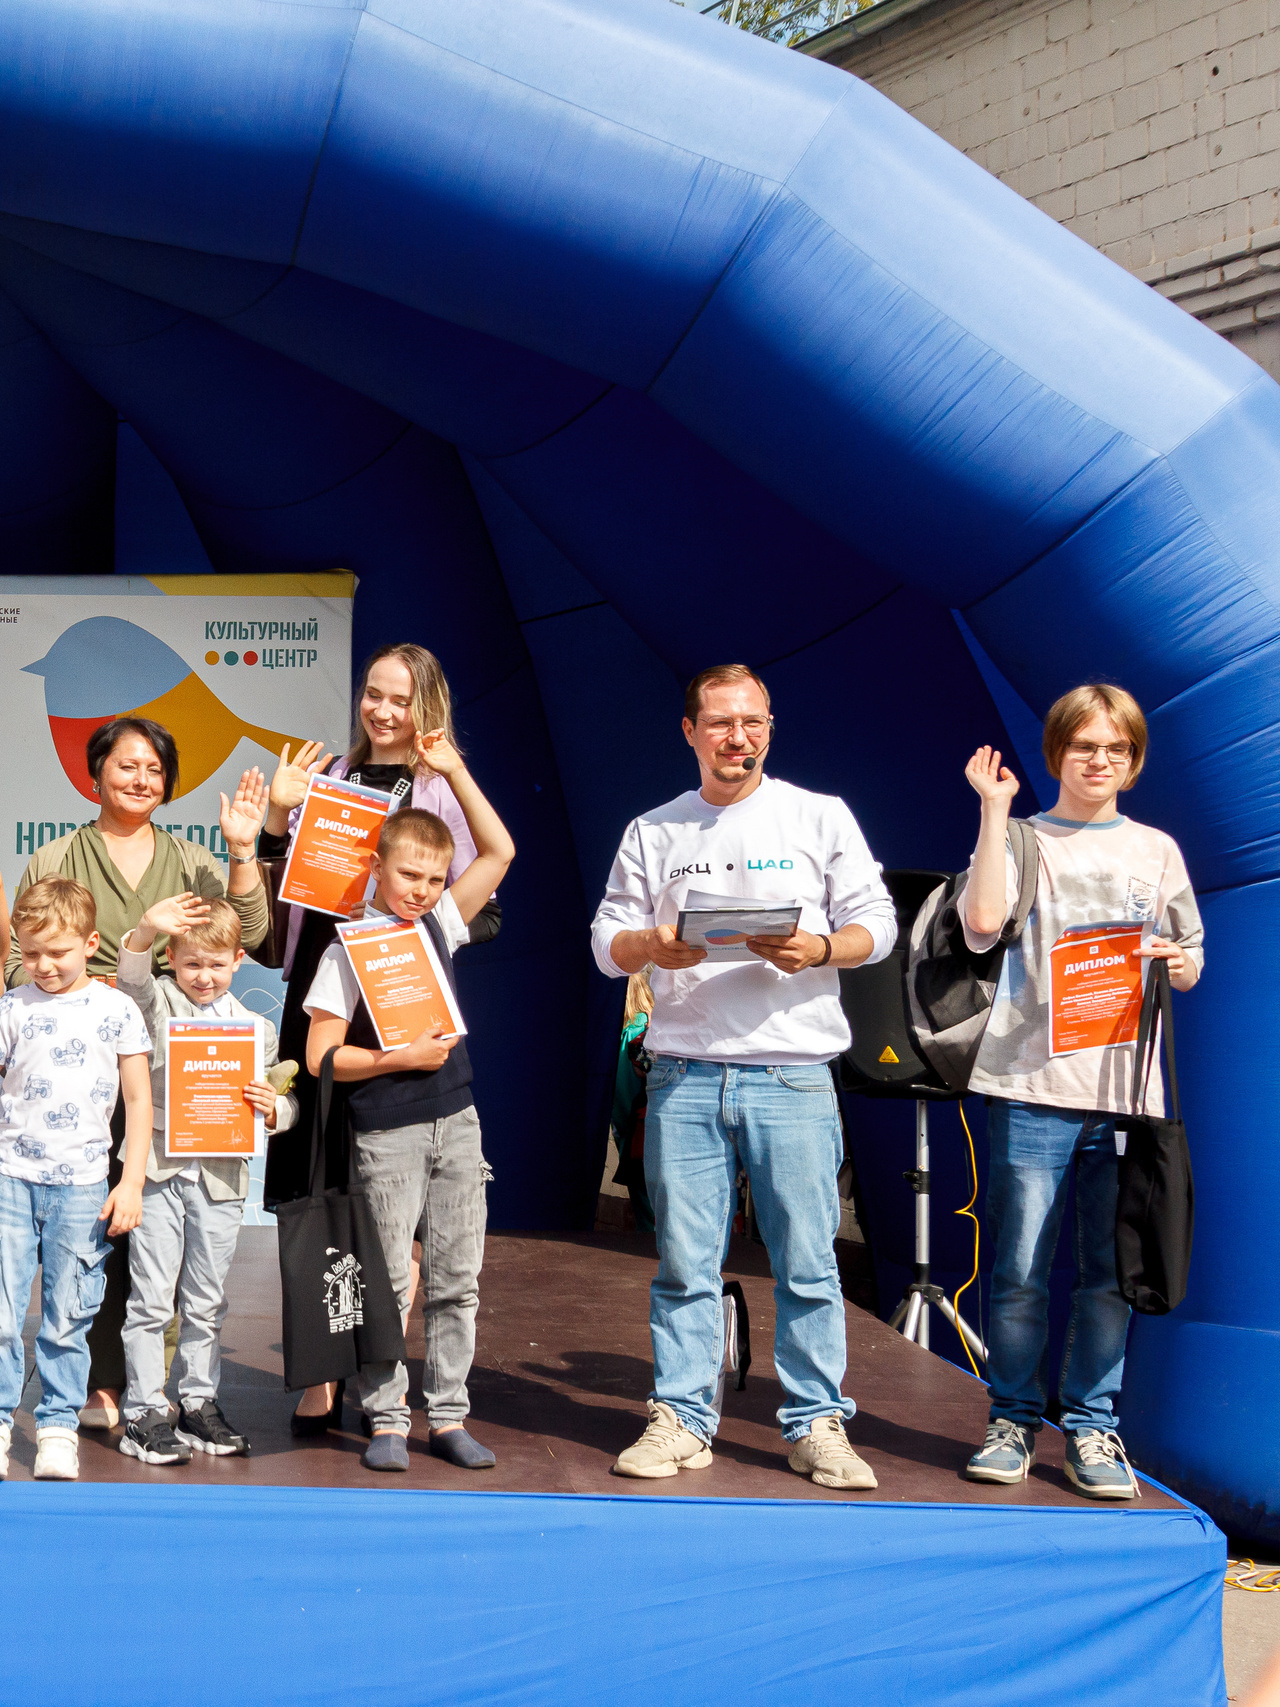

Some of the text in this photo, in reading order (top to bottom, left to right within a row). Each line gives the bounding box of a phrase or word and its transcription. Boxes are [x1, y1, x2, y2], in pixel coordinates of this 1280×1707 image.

[205, 618, 318, 641] КУЛЬТУРНЫЙ
[262, 649, 317, 669] ЦЕНТР
[315, 817, 368, 840] ДИПЛОМ
[670, 859, 793, 879] ОКЦ ЦАО
[365, 952, 416, 972] ДИПЛОМ
[1064, 954, 1126, 976] ДИПЛОМ
[183, 1060, 241, 1073] ДИПЛОМ
